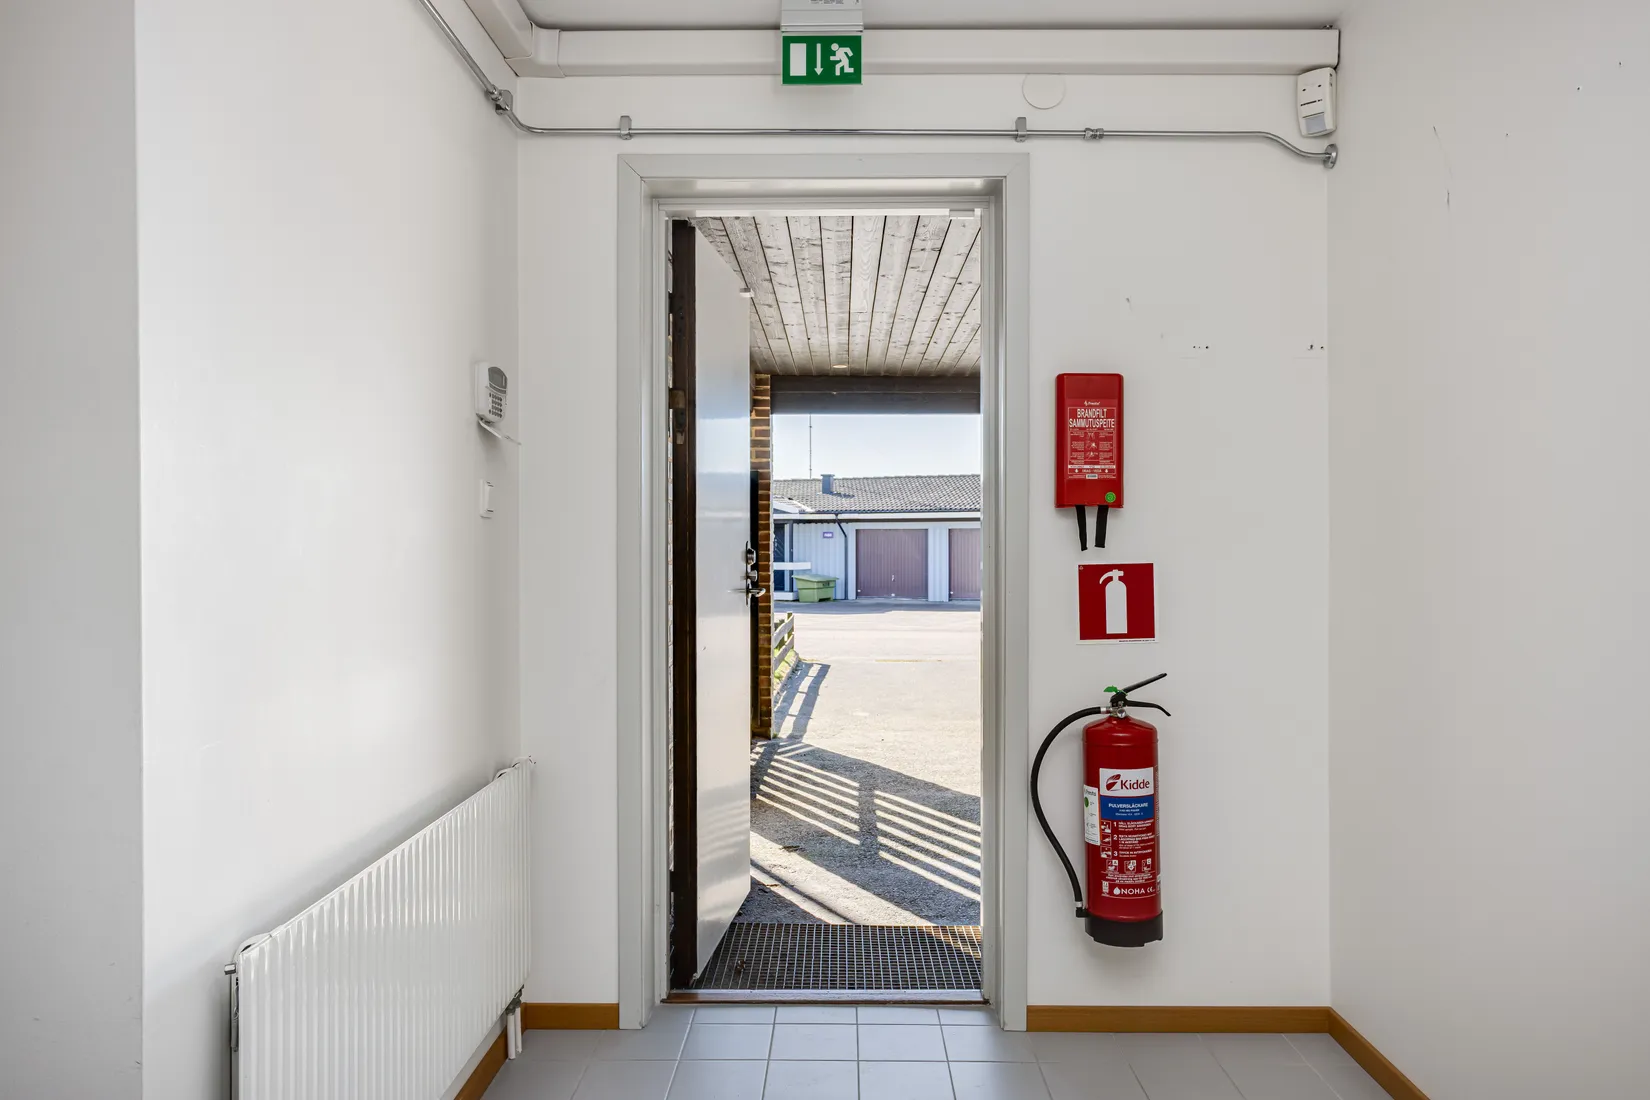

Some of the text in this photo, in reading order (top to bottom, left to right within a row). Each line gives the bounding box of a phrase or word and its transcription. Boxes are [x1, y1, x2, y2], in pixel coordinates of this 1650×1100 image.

[1077, 408, 1107, 418] BRANDFILT
[1069, 418, 1115, 428] SAMMUTUSPEITE
[1120, 779, 1150, 790] Kidde
